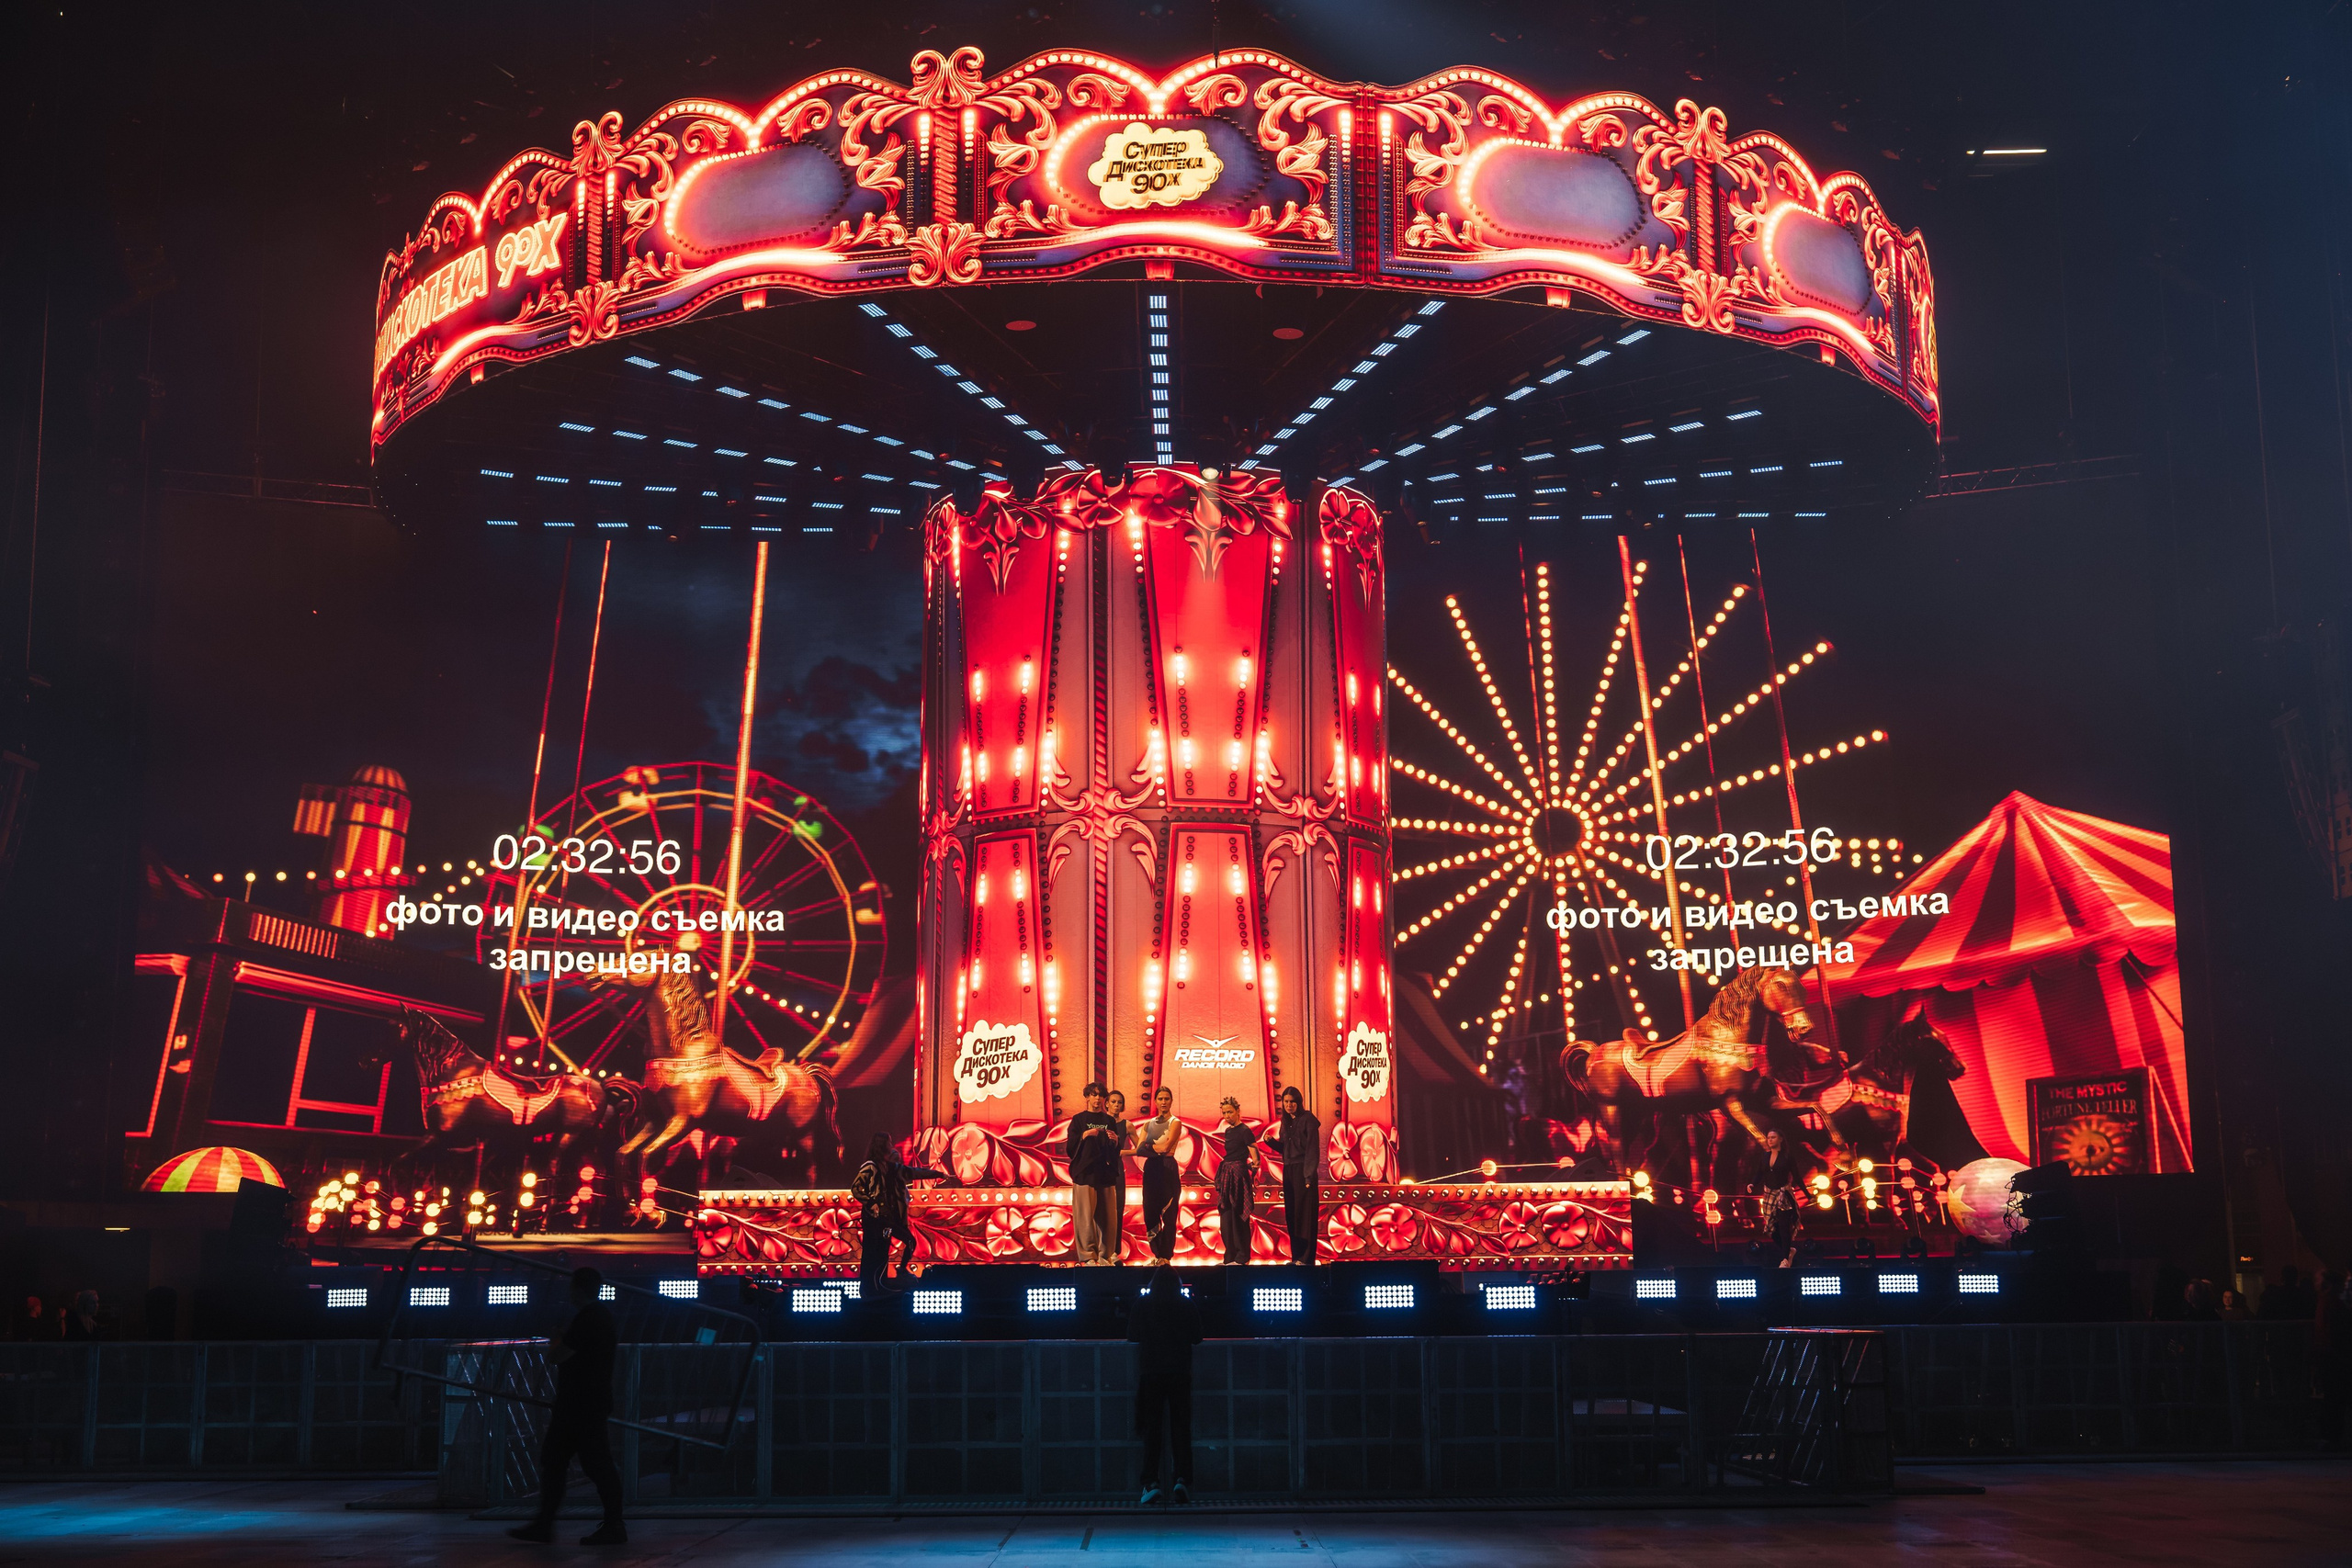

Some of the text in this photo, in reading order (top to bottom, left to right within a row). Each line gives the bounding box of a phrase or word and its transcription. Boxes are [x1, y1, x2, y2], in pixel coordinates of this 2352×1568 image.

[492, 833, 682, 875] 02:32:56
[1645, 828, 1837, 871] 02:32:56
[385, 895, 786, 935] фото и видео съемка
[1545, 891, 1951, 930] фото и видео съемка
[489, 947, 691, 978] запрещена
[1650, 941, 1855, 976] запрещена
[1174, 1049, 1256, 1063] RECORD
[1182, 1061, 1216, 1069] DANCE
[2049, 1080, 2128, 1100] THE MYSTIC
